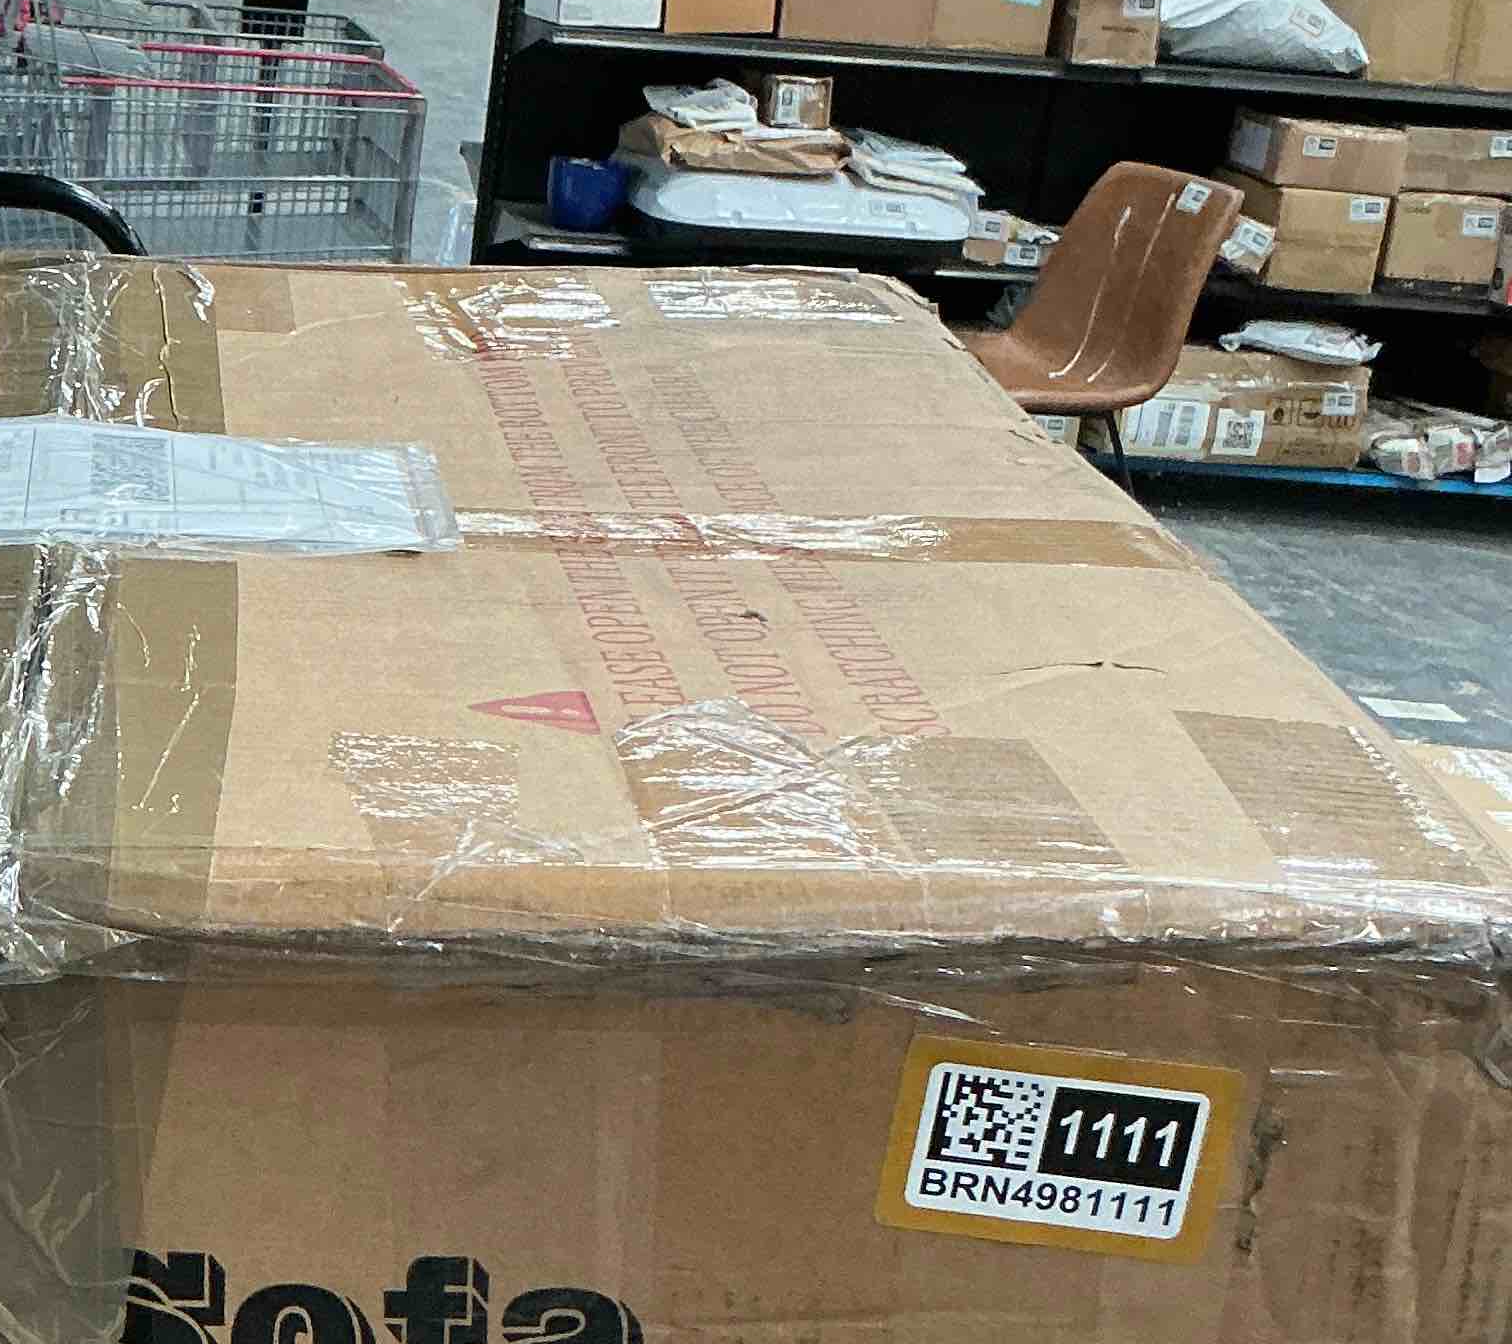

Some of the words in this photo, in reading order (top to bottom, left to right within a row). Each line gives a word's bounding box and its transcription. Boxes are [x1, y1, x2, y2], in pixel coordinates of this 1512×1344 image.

[576, 589, 655, 644] OPEN
[712, 647, 802, 697] NOT
[793, 597, 952, 737] SCRATCHING
[1059, 1109, 1179, 1168] 1111
[919, 1167, 1177, 1227] BRN4981111
